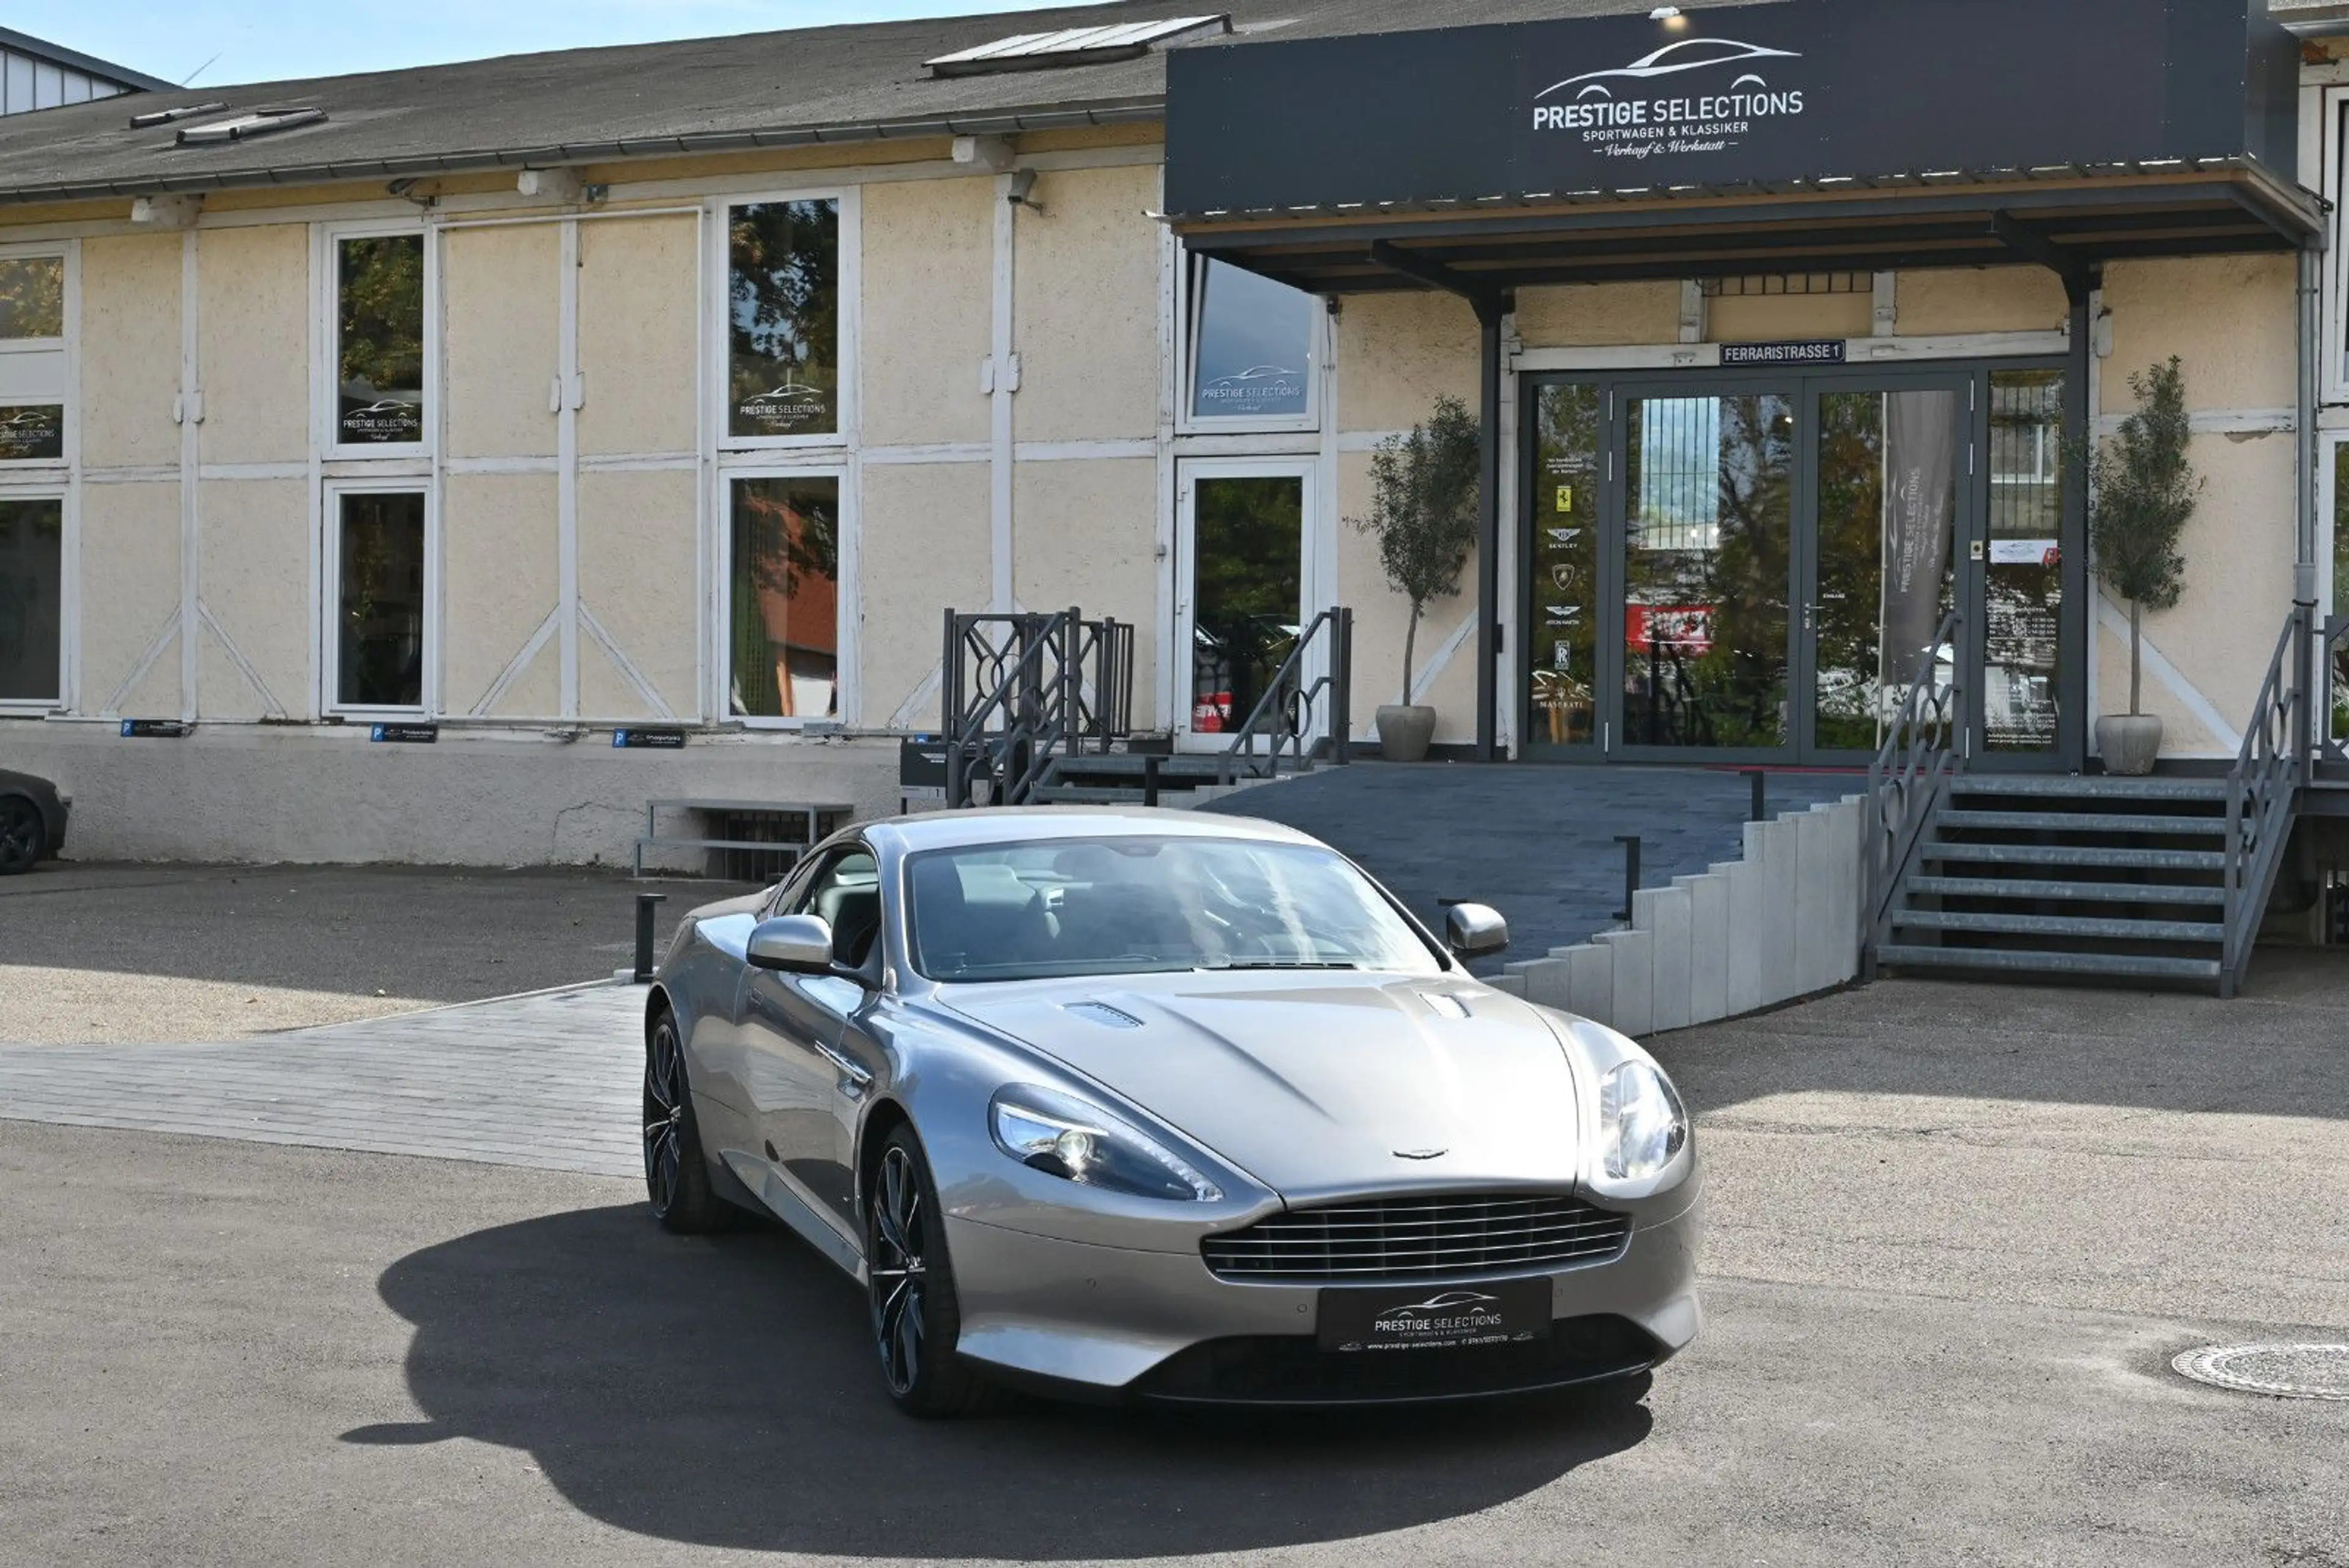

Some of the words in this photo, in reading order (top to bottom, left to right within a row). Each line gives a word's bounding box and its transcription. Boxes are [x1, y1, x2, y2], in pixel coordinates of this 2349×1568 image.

[1534, 100, 1647, 130] PRESTIGE
[1653, 91, 1803, 122] SELECTIONS
[1583, 127, 1664, 142] SPORTWAGEN
[1669, 126, 1677, 136] &
[1682, 122, 1748, 136] KLASSIKER
[1605, 141, 1652, 159] Verkauf
[1653, 142, 1665, 153] &
[1668, 139, 1725, 153] Werkstatt
[1724, 344, 1830, 361] FERRARISTRASSE
[1833, 344, 1839, 357] 1
[1203, 388, 1245, 398] PRESTIGE
[1246, 386, 1302, 398] SELECTIONS
[740, 405, 777, 415] PRESTIGE
[778, 403, 826, 414] SELECTIONS
[343, 418, 375, 428] PRESTIGE
[377, 418, 418, 428] SELECTIONS
[1906, 467, 1921, 537] SELECTIONS
[1901, 539, 1914, 593] PRESTIGE
[374, 727, 381, 738] P
[616, 732, 623, 744] P
[1375, 1318, 1431, 1331] PRESTIGE
[1434, 1313, 1502, 1329] SELECTIONS
